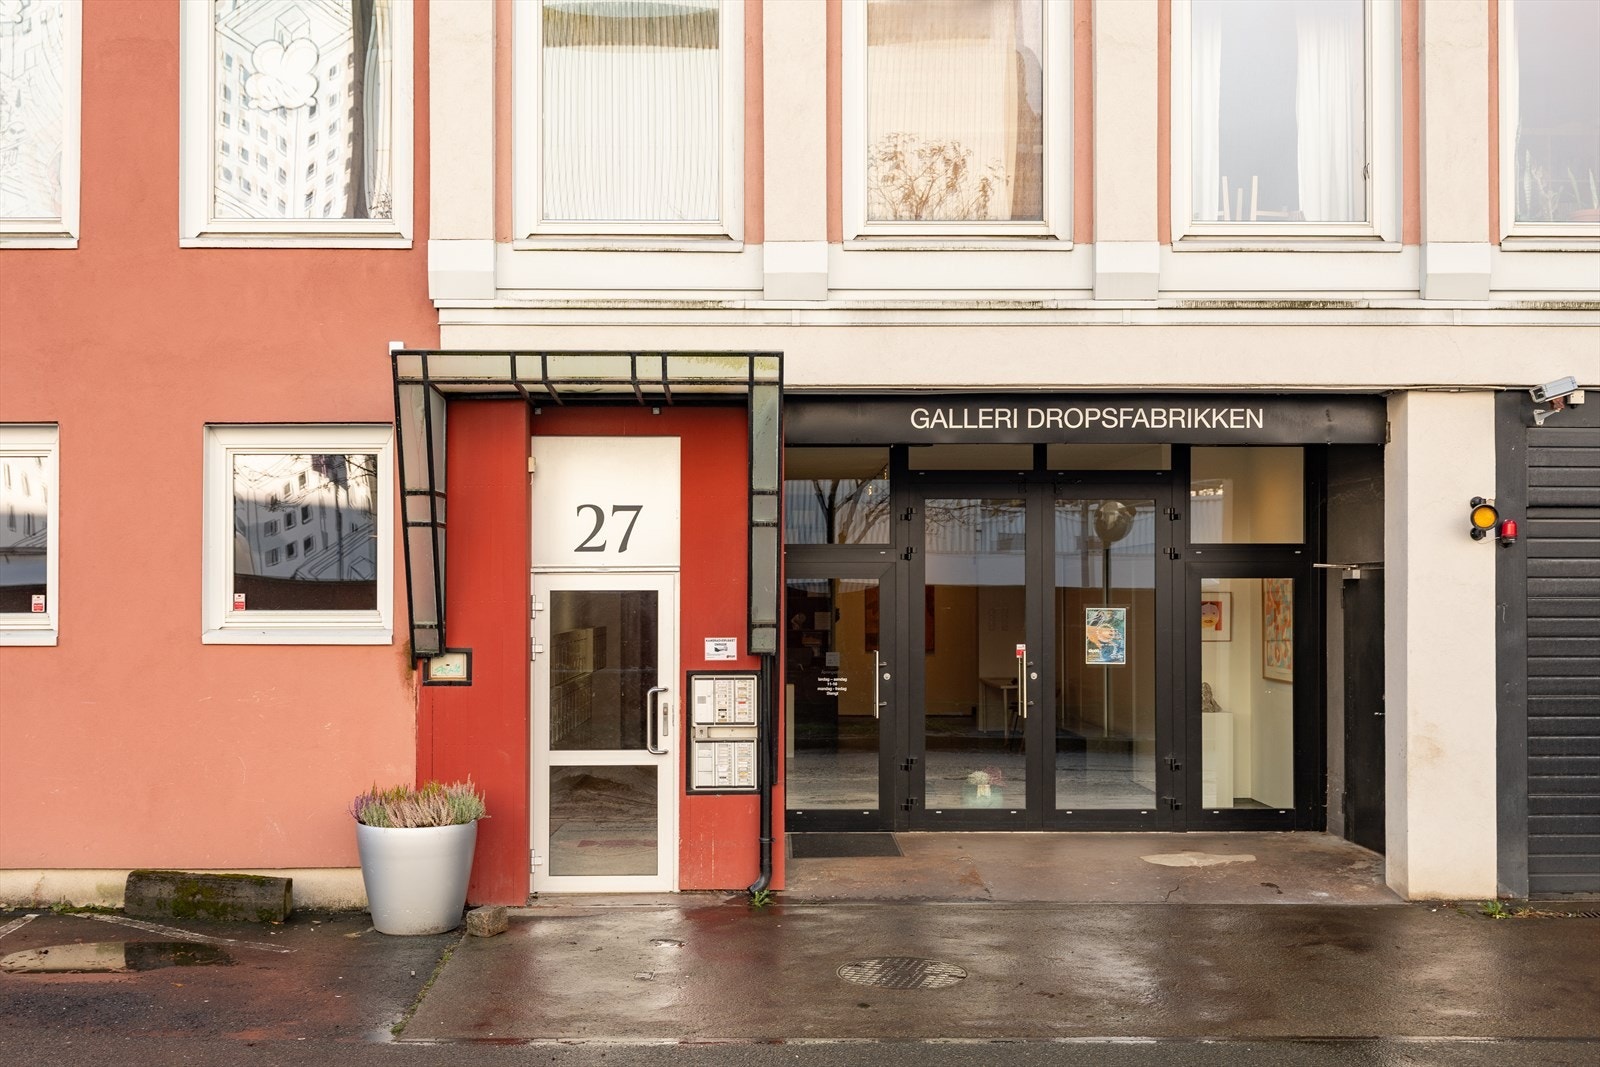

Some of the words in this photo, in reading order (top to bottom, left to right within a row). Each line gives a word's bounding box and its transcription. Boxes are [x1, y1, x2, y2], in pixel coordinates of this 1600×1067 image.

[910, 408, 1018, 429] GALLERI
[1027, 408, 1264, 429] DROPSFABRIKKEN
[573, 503, 644, 553] 27
